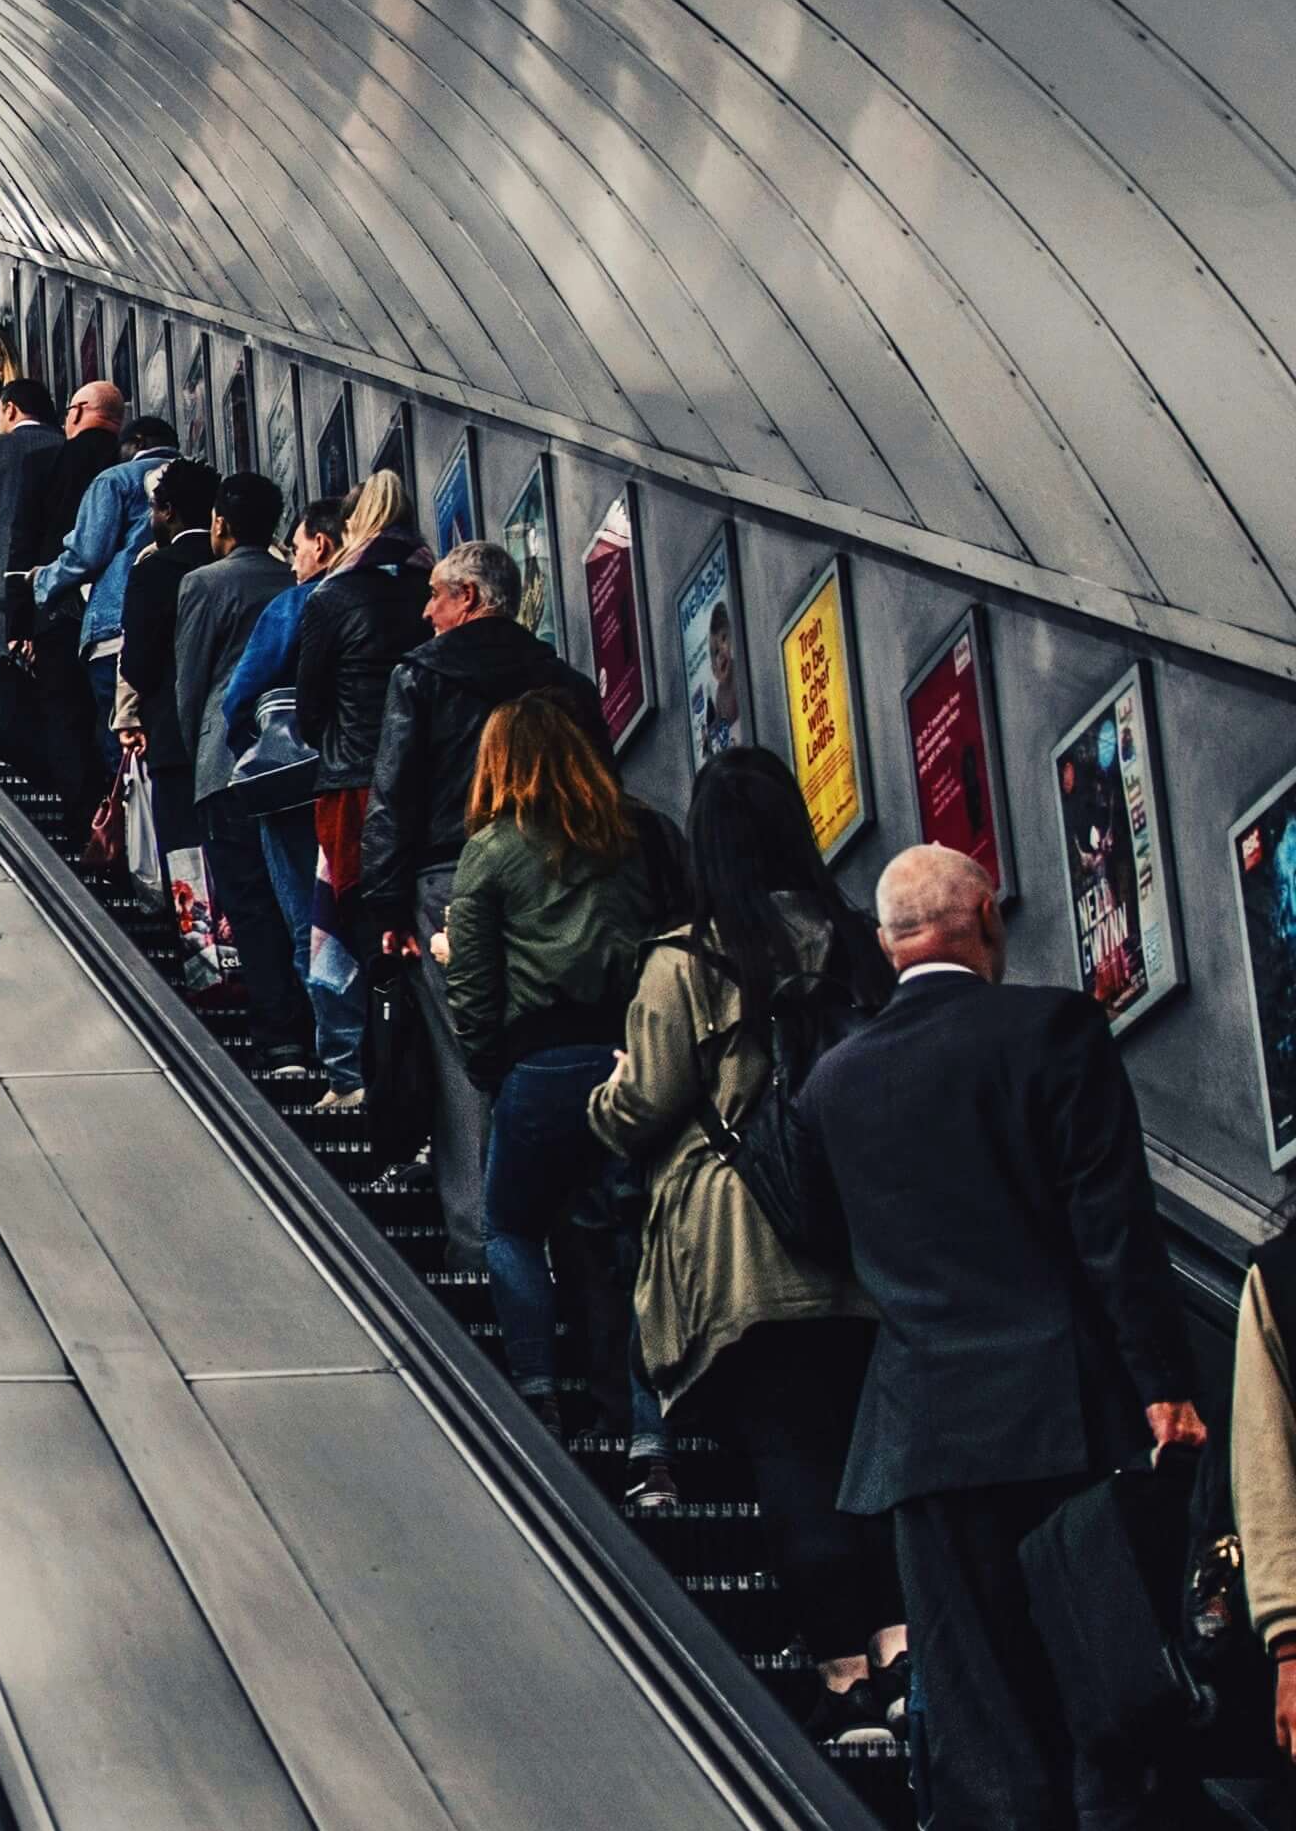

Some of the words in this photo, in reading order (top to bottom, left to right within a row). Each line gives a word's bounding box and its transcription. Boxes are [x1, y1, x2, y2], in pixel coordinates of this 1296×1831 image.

[799, 618, 823, 658] Train
[801, 661, 812, 684] to
[812, 644, 825, 671] be
[802, 694, 809, 714] a
[810, 658, 832, 703] chef
[808, 697, 829, 734] with
[806, 720, 835, 766] Leiths
[1077, 877, 1114, 936] NELL
[1082, 901, 1129, 975] GWYNN
